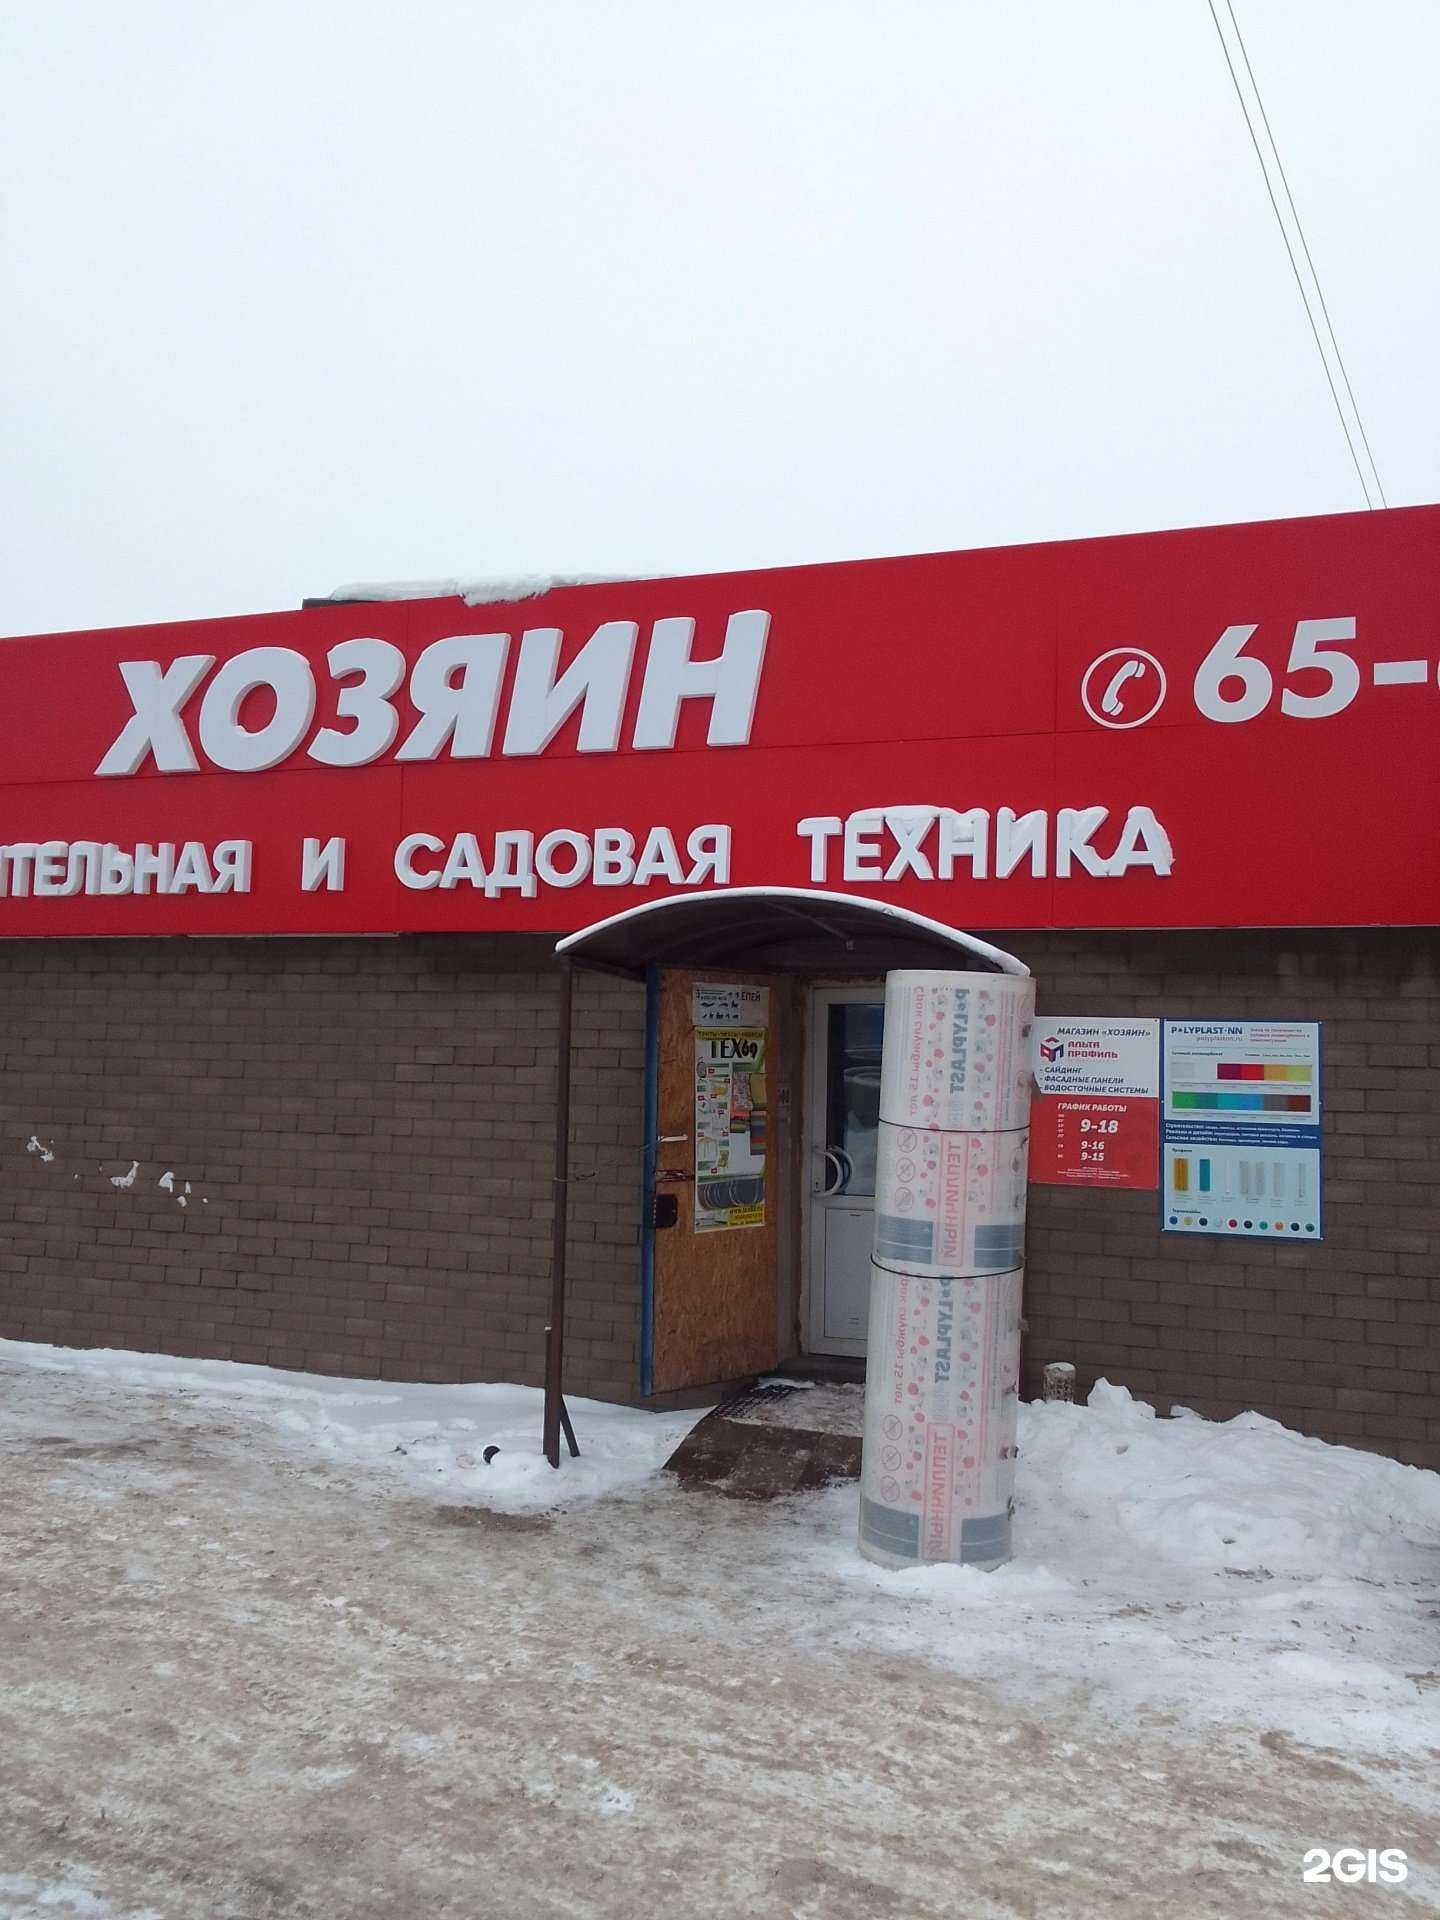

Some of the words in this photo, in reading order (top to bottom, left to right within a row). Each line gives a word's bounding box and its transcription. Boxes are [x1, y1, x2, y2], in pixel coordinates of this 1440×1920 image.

[1193, 616, 1440, 723] 65-
[94, 609, 772, 776] ХОЗЯИН
[301, 838, 346, 893] И
[394, 824, 731, 899] САДОВАЯ
[797, 805, 1176, 883] ТЕХНИКА
[1057, 1027, 1099, 1036] МАГАЗИН
[1067, 1050, 1118, 1059] ПРОФИЛЬ
[1044, 1066, 1083, 1074] САЙДИНГ
[1044, 1076, 1090, 1084] ФАСАДНЫЕ
[1091, 1077, 1124, 1085] ПАНЕЛИ
[1044, 1086, 1106, 1094] ВОДОСТОЧНЫЕ
[1108, 1087, 1149, 1095] СИСТЕМЫ
[1057, 1103, 1091, 1111] ГРАФИК
[1092, 1103, 1127, 1112] РАБОТЫ
[1080, 1118, 1119, 1134] 9-18
[1080, 1141, 1105, 1151] 9-16
[1080, 1152, 1105, 1162] 9-15
